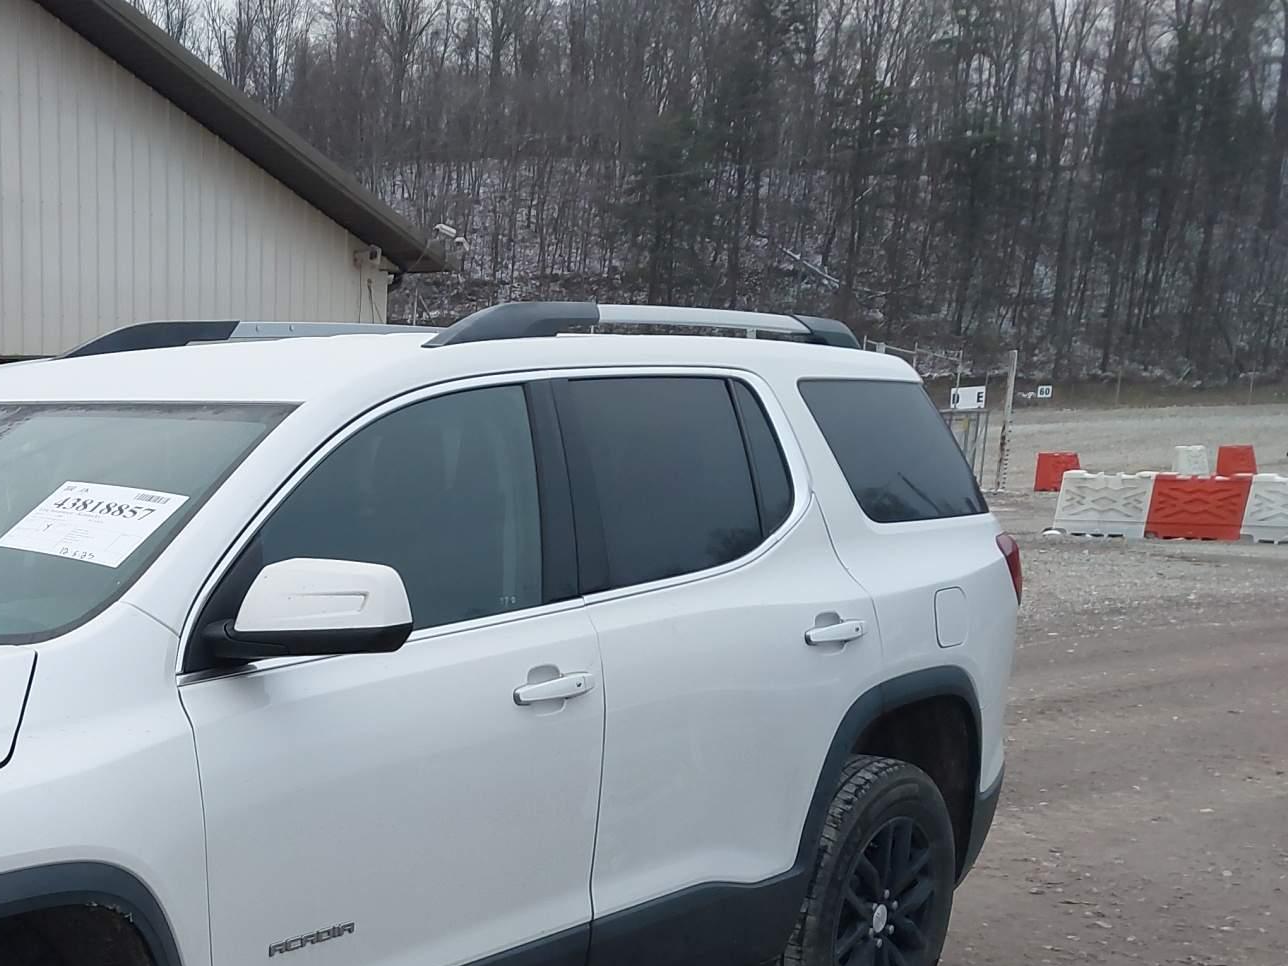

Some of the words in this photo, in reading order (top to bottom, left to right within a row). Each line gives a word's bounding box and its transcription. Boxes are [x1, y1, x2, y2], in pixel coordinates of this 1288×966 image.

[977, 392, 983, 402] E
[1039, 388, 1050, 396] 60
[54, 496, 156, 520] 43818857
[268, 921, 355, 958] ACADIA
